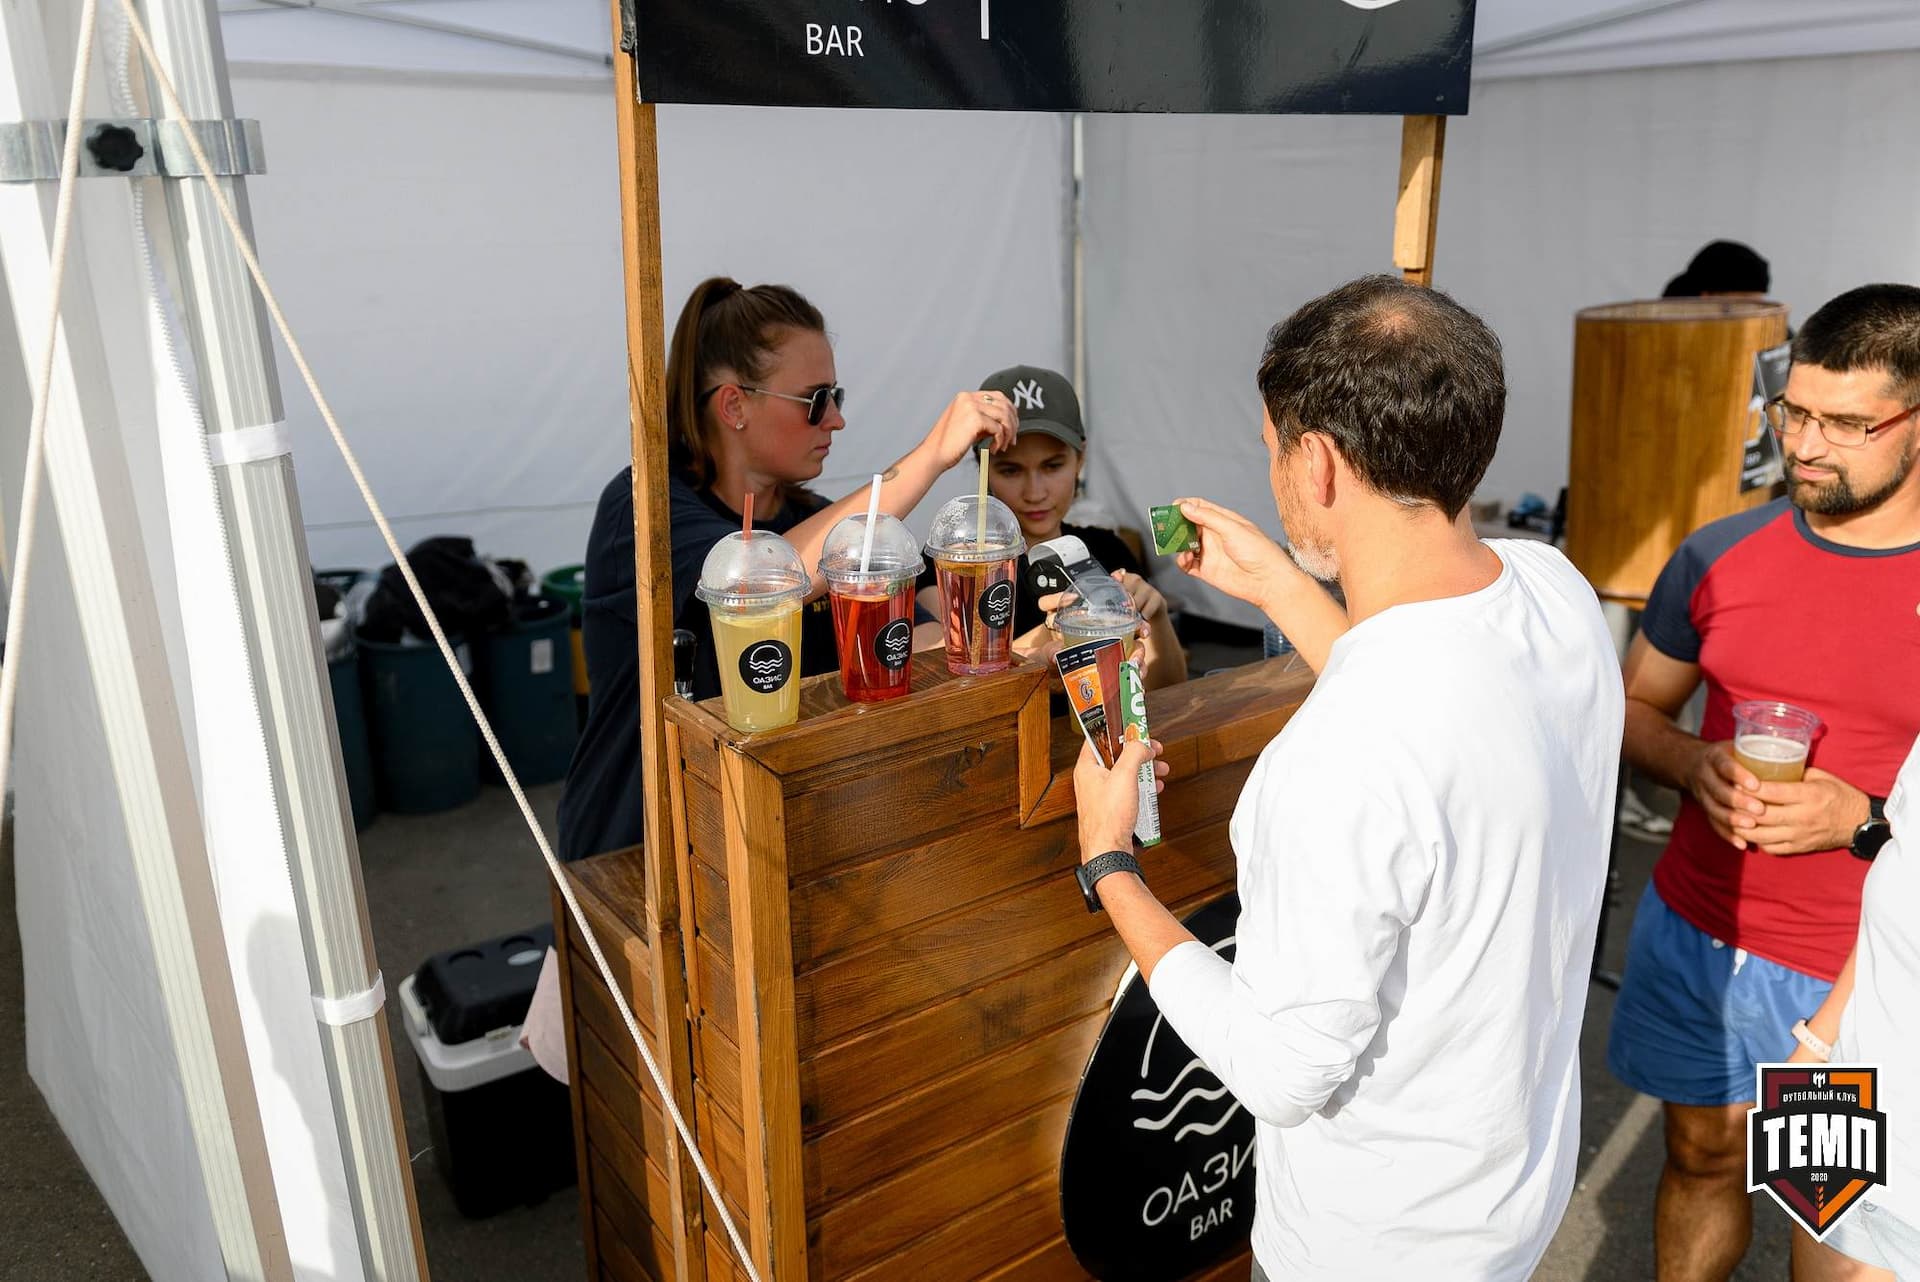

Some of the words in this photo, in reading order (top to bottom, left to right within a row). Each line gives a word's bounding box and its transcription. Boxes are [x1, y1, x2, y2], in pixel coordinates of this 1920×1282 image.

[806, 23, 865, 57] BAR
[1012, 379, 1045, 409] NY
[752, 673, 783, 685] ОАЗИС
[1142, 1135, 1256, 1227] ОАЗИ
[1190, 1197, 1234, 1241] BAR
